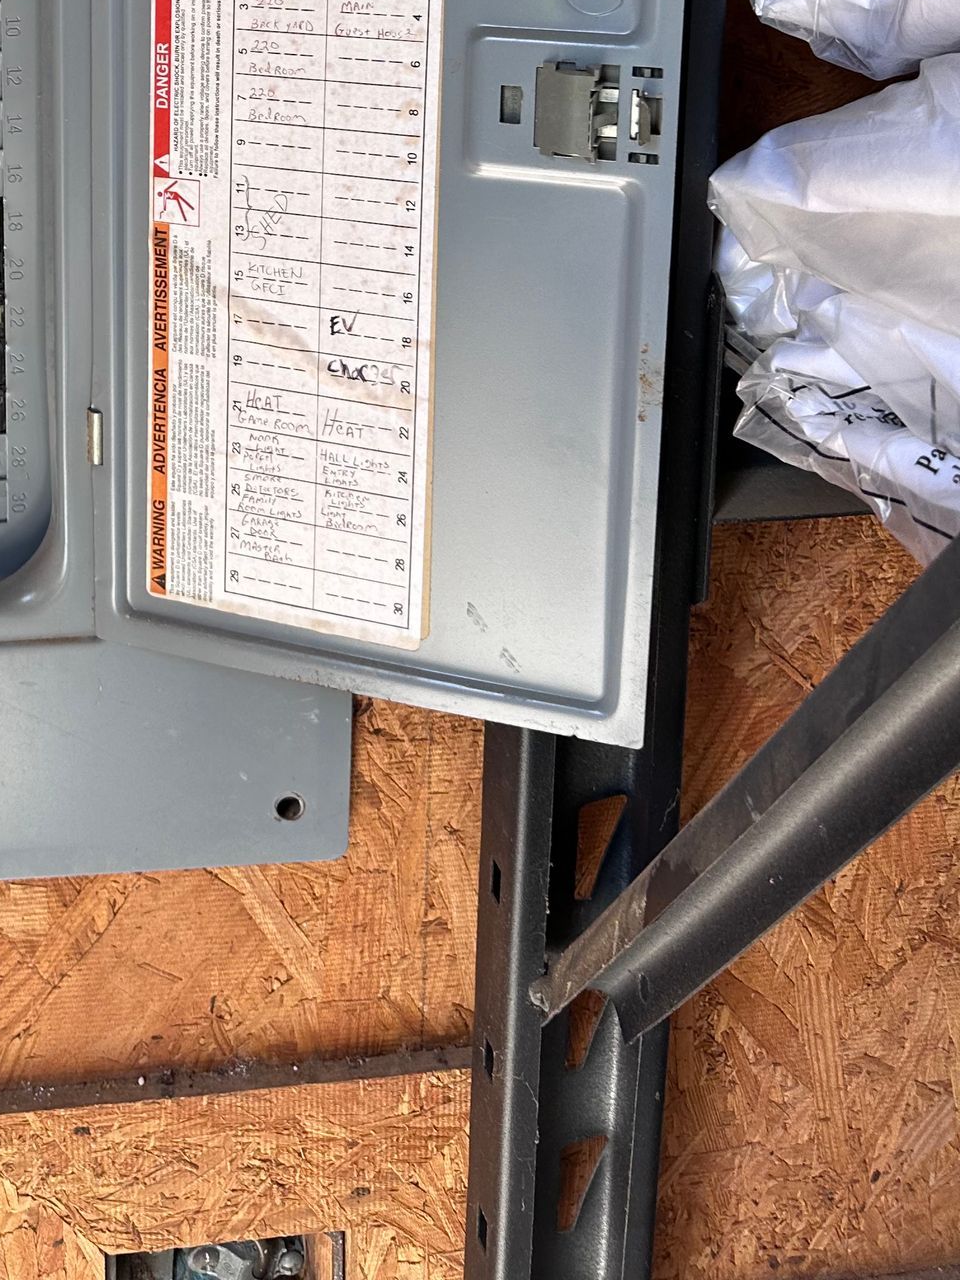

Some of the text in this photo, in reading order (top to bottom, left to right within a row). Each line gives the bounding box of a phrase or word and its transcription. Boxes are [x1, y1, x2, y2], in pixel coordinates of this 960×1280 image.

[5, 16, 21, 37] 10
[251, 19, 279, 29] BACK
[251, 41, 279, 51] 220
[7, 66, 22, 86] 12
[156, 43, 169, 109] DANGER
[250, 88, 275, 97] 220
[7, 114, 23, 134] 14
[408, 153, 416, 165] 10
[8, 165, 23, 183] 16
[237, 183, 244, 193] 11
[406, 200, 415, 212] 12
[8, 212, 23, 231] 18
[252, 194, 288, 250] SHED
[236, 225, 244, 236] 13
[405, 246, 413, 257] 14
[9, 259, 24, 280] 20
[235, 270, 243, 281] 15
[248, 262, 303, 278] KITCHEN
[154, 227, 168, 352] AVERTISSEMENT
[251, 280, 285, 295] GFCI
[404, 292, 412, 304] 16
[10, 307, 25, 327] 22
[234, 314, 242, 324] 17
[329, 309, 361, 336] EV
[402, 337, 411, 349] 18
[10, 353, 25, 374] 24
[234, 355, 242, 366] 19
[401, 381, 410, 394] 20
[11, 399, 26, 421] 26
[233, 400, 241, 411] 21
[154, 368, 166, 474] ADVERTENCIA
[400, 427, 409, 440] 22
[233, 442, 241, 454] 23
[11, 447, 26, 467] 28
[399, 471, 408, 484] 24
[232, 483, 240, 495] 25
[11, 492, 26, 513] 30
[398, 514, 406, 526] 26
[153, 500, 165, 570] WARNING
[231, 529, 239, 539] 27
[395, 559, 404, 571] 28
[230, 570, 239, 582] 29
[394, 603, 403, 615] 30
